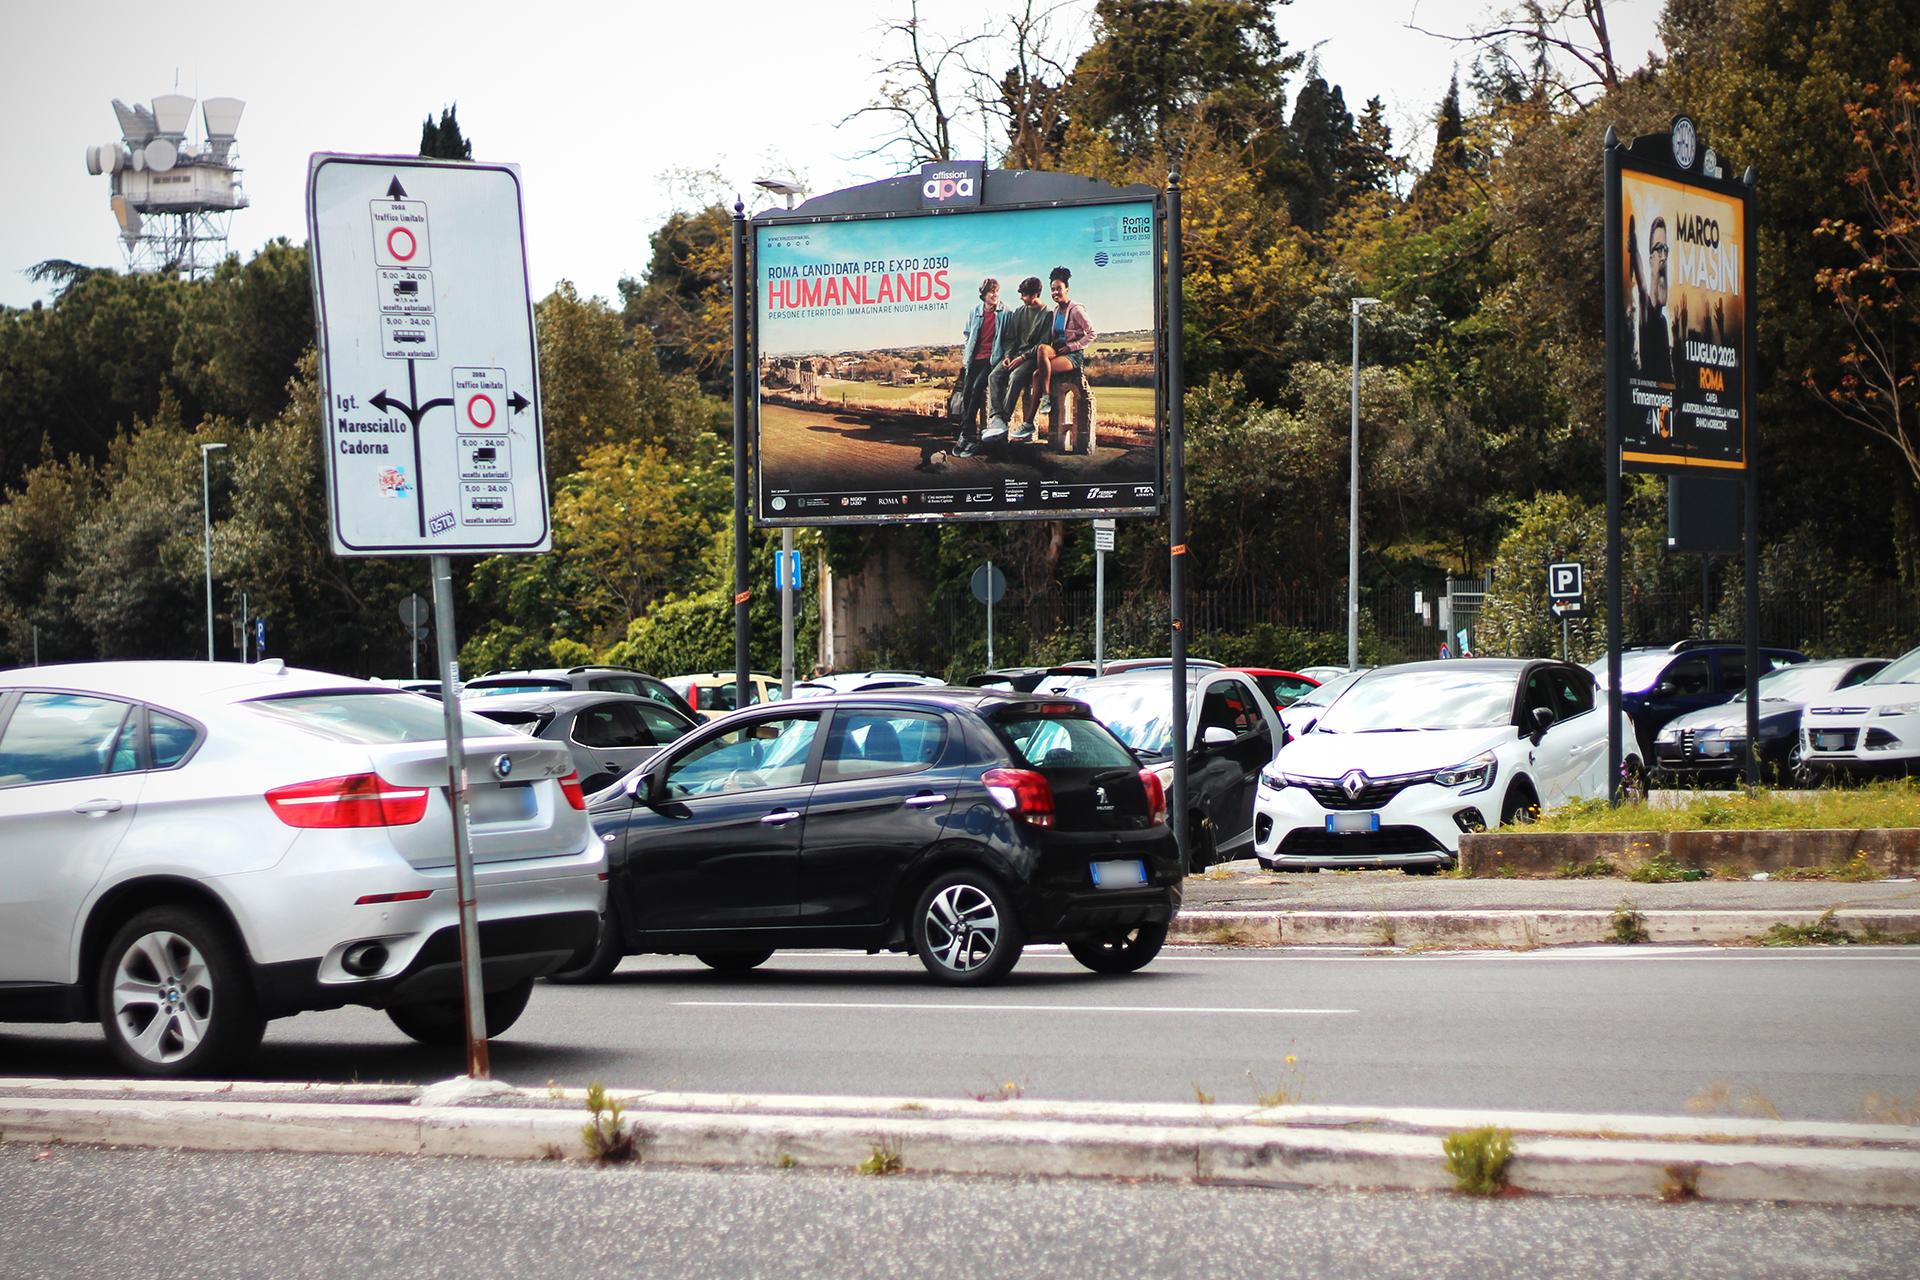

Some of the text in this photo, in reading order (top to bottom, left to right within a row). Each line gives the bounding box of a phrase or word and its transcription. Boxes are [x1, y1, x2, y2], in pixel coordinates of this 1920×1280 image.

[932, 170, 968, 180] affissioni
[923, 178, 974, 201] apa
[375, 213, 424, 222] traffico limitato
[1122, 216, 1150, 226] Roma
[1122, 224, 1150, 234] Italia
[1676, 211, 1720, 249] MARCO
[768, 256, 949, 278] ROMA CANDIDATA PER EXPO 2030
[1680, 241, 1739, 296] MASINI
[768, 270, 951, 310] HUMANLANDS
[768, 310, 800, 320] PERSONE
[802, 310, 806, 318] E
[848, 305, 892, 316] IMMAGINARE
[894, 304, 917, 312] NUOVI
[919, 302, 949, 312] HABITAT
[1686, 340, 1736, 368] 1 LUGLIO 2023
[456, 380, 503, 389] traffico limitato
[1700, 366, 1724, 392] ROMA
[338, 418, 406, 432] Maresciallo
[340, 440, 389, 454] Cadorna
[1558, 570, 1574, 592] P
[258, 622, 264, 638] P
